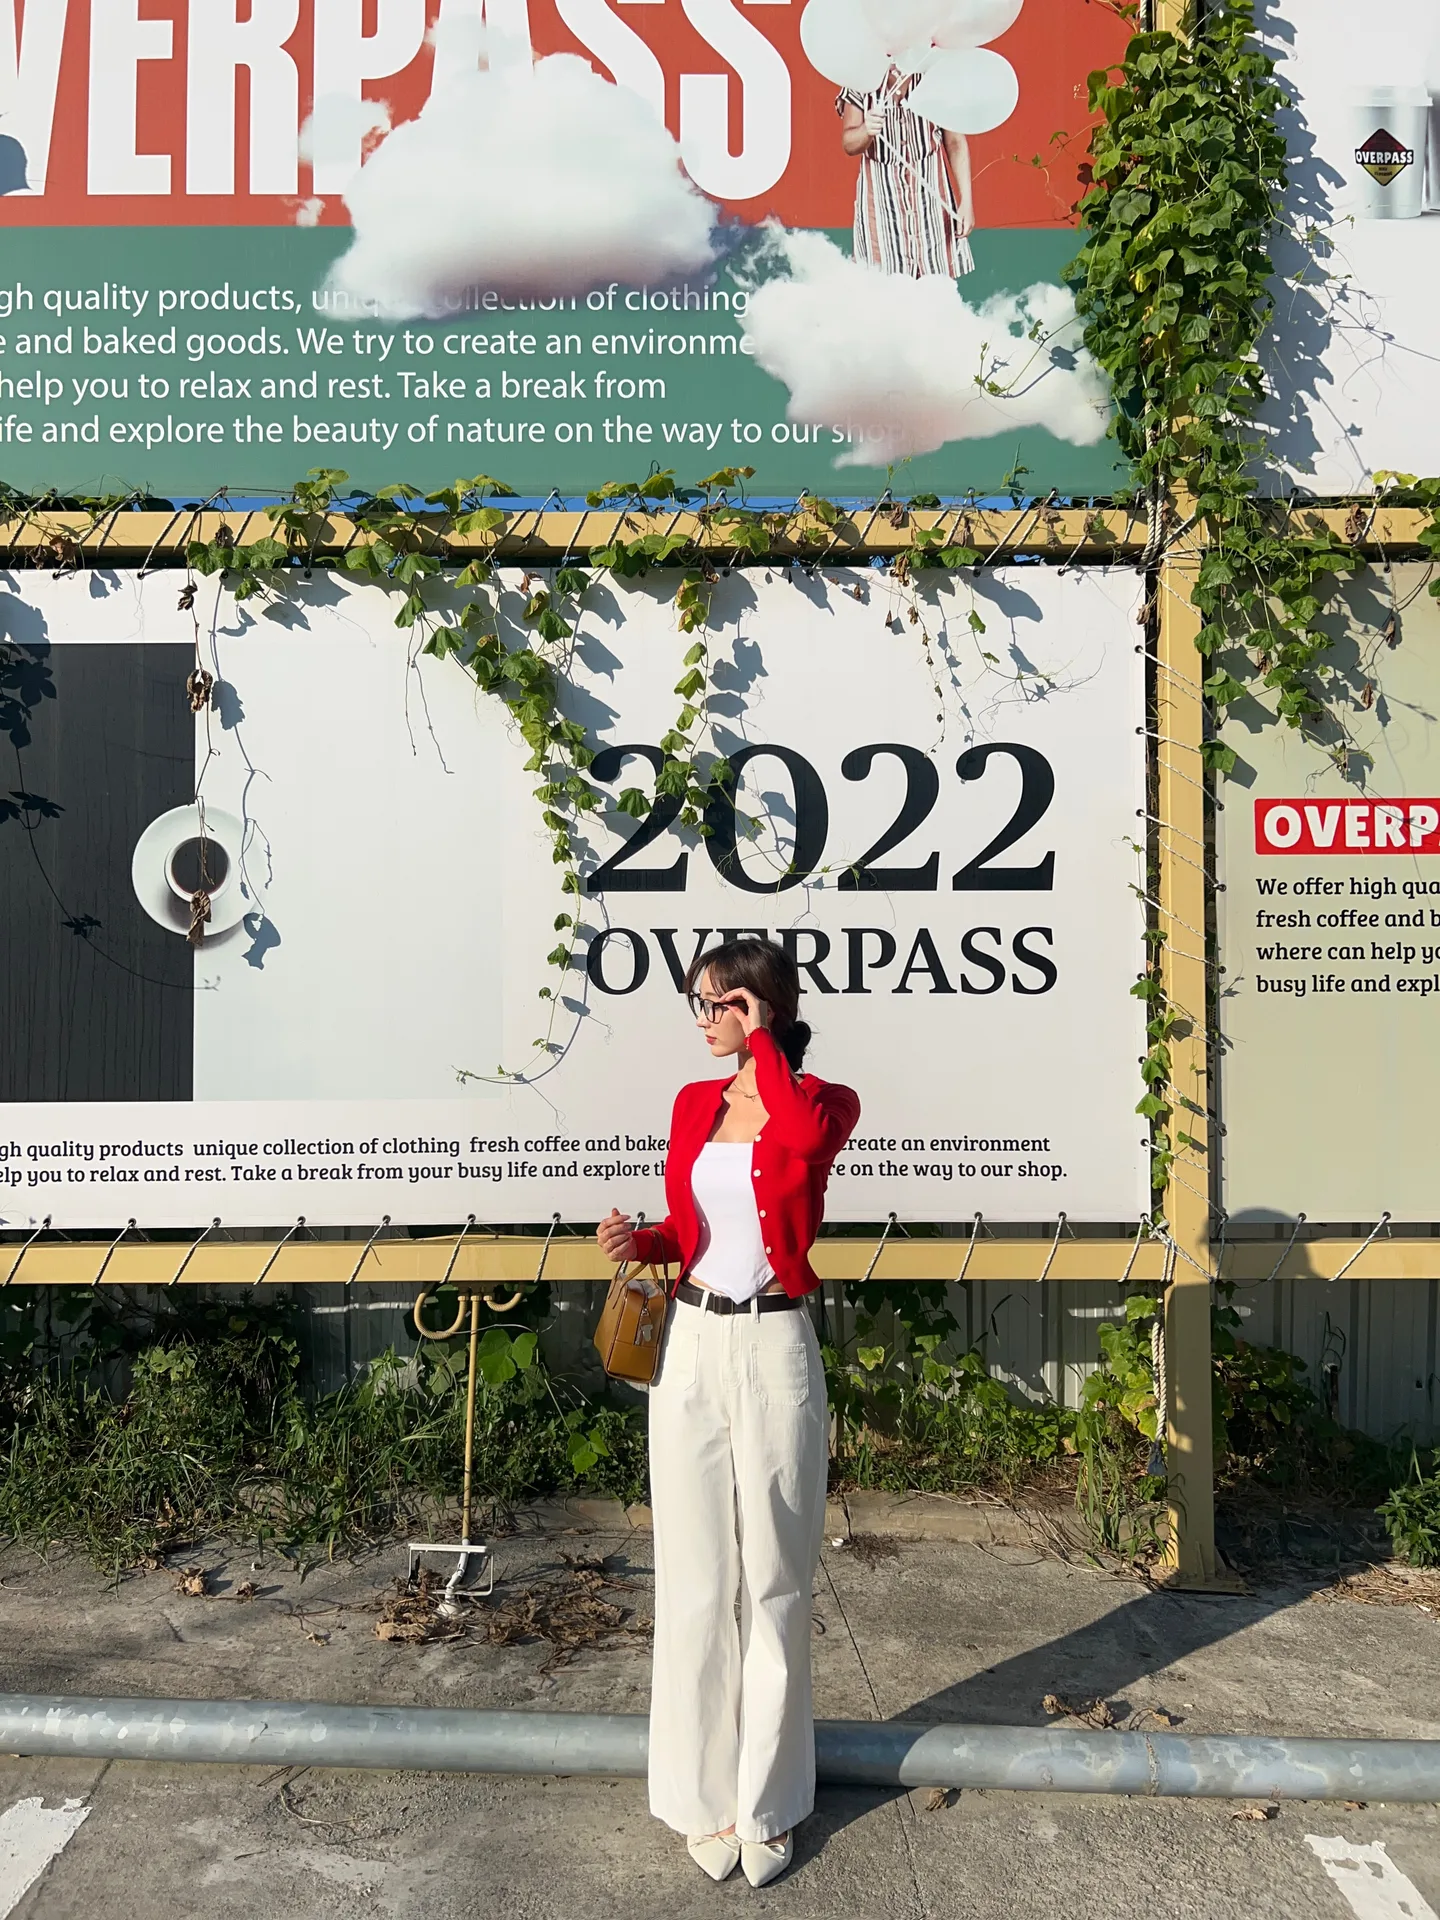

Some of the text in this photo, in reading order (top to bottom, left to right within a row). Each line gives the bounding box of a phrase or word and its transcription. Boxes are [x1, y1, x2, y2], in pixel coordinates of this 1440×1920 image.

[1356, 151, 1412, 163] OVERPASS
[0, 283, 33, 317] gh
[43, 282, 149, 317] quality
[159, 282, 302, 318] products,
[586, 283, 618, 311] of
[625, 283, 749, 318] clothing
[15, 326, 72, 354] and
[83, 326, 175, 354] baked
[187, 326, 289, 361] goods.
[297, 328, 344, 355] We
[353, 331, 395, 362] try
[402, 331, 434, 355] to
[443, 331, 537, 355] create
[546, 335, 582, 355] an
[591, 329, 758, 355] environme
[0, 370, 666, 405] help you to relax and rest. Take a break from
[42, 414, 99, 443] and
[109, 415, 224, 450] explore
[232, 415, 283, 443] the
[293, 415, 399, 450] beauty
[407, 415, 440, 443] of
[447, 419, 546, 443] nature
[555, 423, 593, 443] on
[602, 415, 653, 443] the
[661, 423, 723, 451] way
[731, 418, 762, 443] to
[771, 423, 823, 443] our
[586, 741, 1056, 893] 2022
[1263, 804, 1440, 848] OVERP
[1256, 877, 1440, 900] We offer high qua
[1256, 909, 1312, 928] fresh
[1316, 909, 1380, 928] coffee
[1385, 909, 1425, 928] and
[586, 926, 1058, 995] OVRPASS
[1256, 942, 1323, 960] where
[1327, 946, 1366, 960] can
[1371, 941, 1416, 964] help
[1256, 974, 1306, 997] busy
[1312, 974, 1346, 993] life
[1351, 974, 1392, 993] and
[26, 1140, 94, 1162] quality
[99, 1140, 184, 1161] products
[193, 1139, 259, 1160] unique
[263, 1138, 355, 1157] collection
[359, 1137, 380, 1155] of
[382, 1137, 460, 1158] clothing
[469, 1136, 520, 1153] fresh
[524, 1135, 581, 1153] coffee
[585, 1135, 621, 1152] and
[840, 1136, 897, 1152] reate
[901, 1138, 926, 1152] an
[929, 1135, 1051, 1152] environment
[27, 1170, 62, 1187] you
[66, 1168, 85, 1183] to
[89, 1166, 140, 1182] relax
[143, 1166, 180, 1182] and
[184, 1167, 227, 1182] rest.
[230, 1165, 277, 1181] Take
[281, 1168, 293, 1181] a
[297, 1163, 353, 1181] break
[356, 1163, 404, 1180] from
[408, 1166, 454, 1184] your
[457, 1162, 503, 1183] busy
[507, 1161, 538, 1178] life
[542, 1160, 579, 1178] and
[582, 1160, 650, 1180] explore
[850, 1163, 874, 1177] on
[878, 1159, 909, 1177] the
[912, 1164, 954, 1181] way
[957, 1162, 977, 1177] to
[980, 1163, 1014, 1177] our
[1017, 1160, 1067, 1181] shop.
